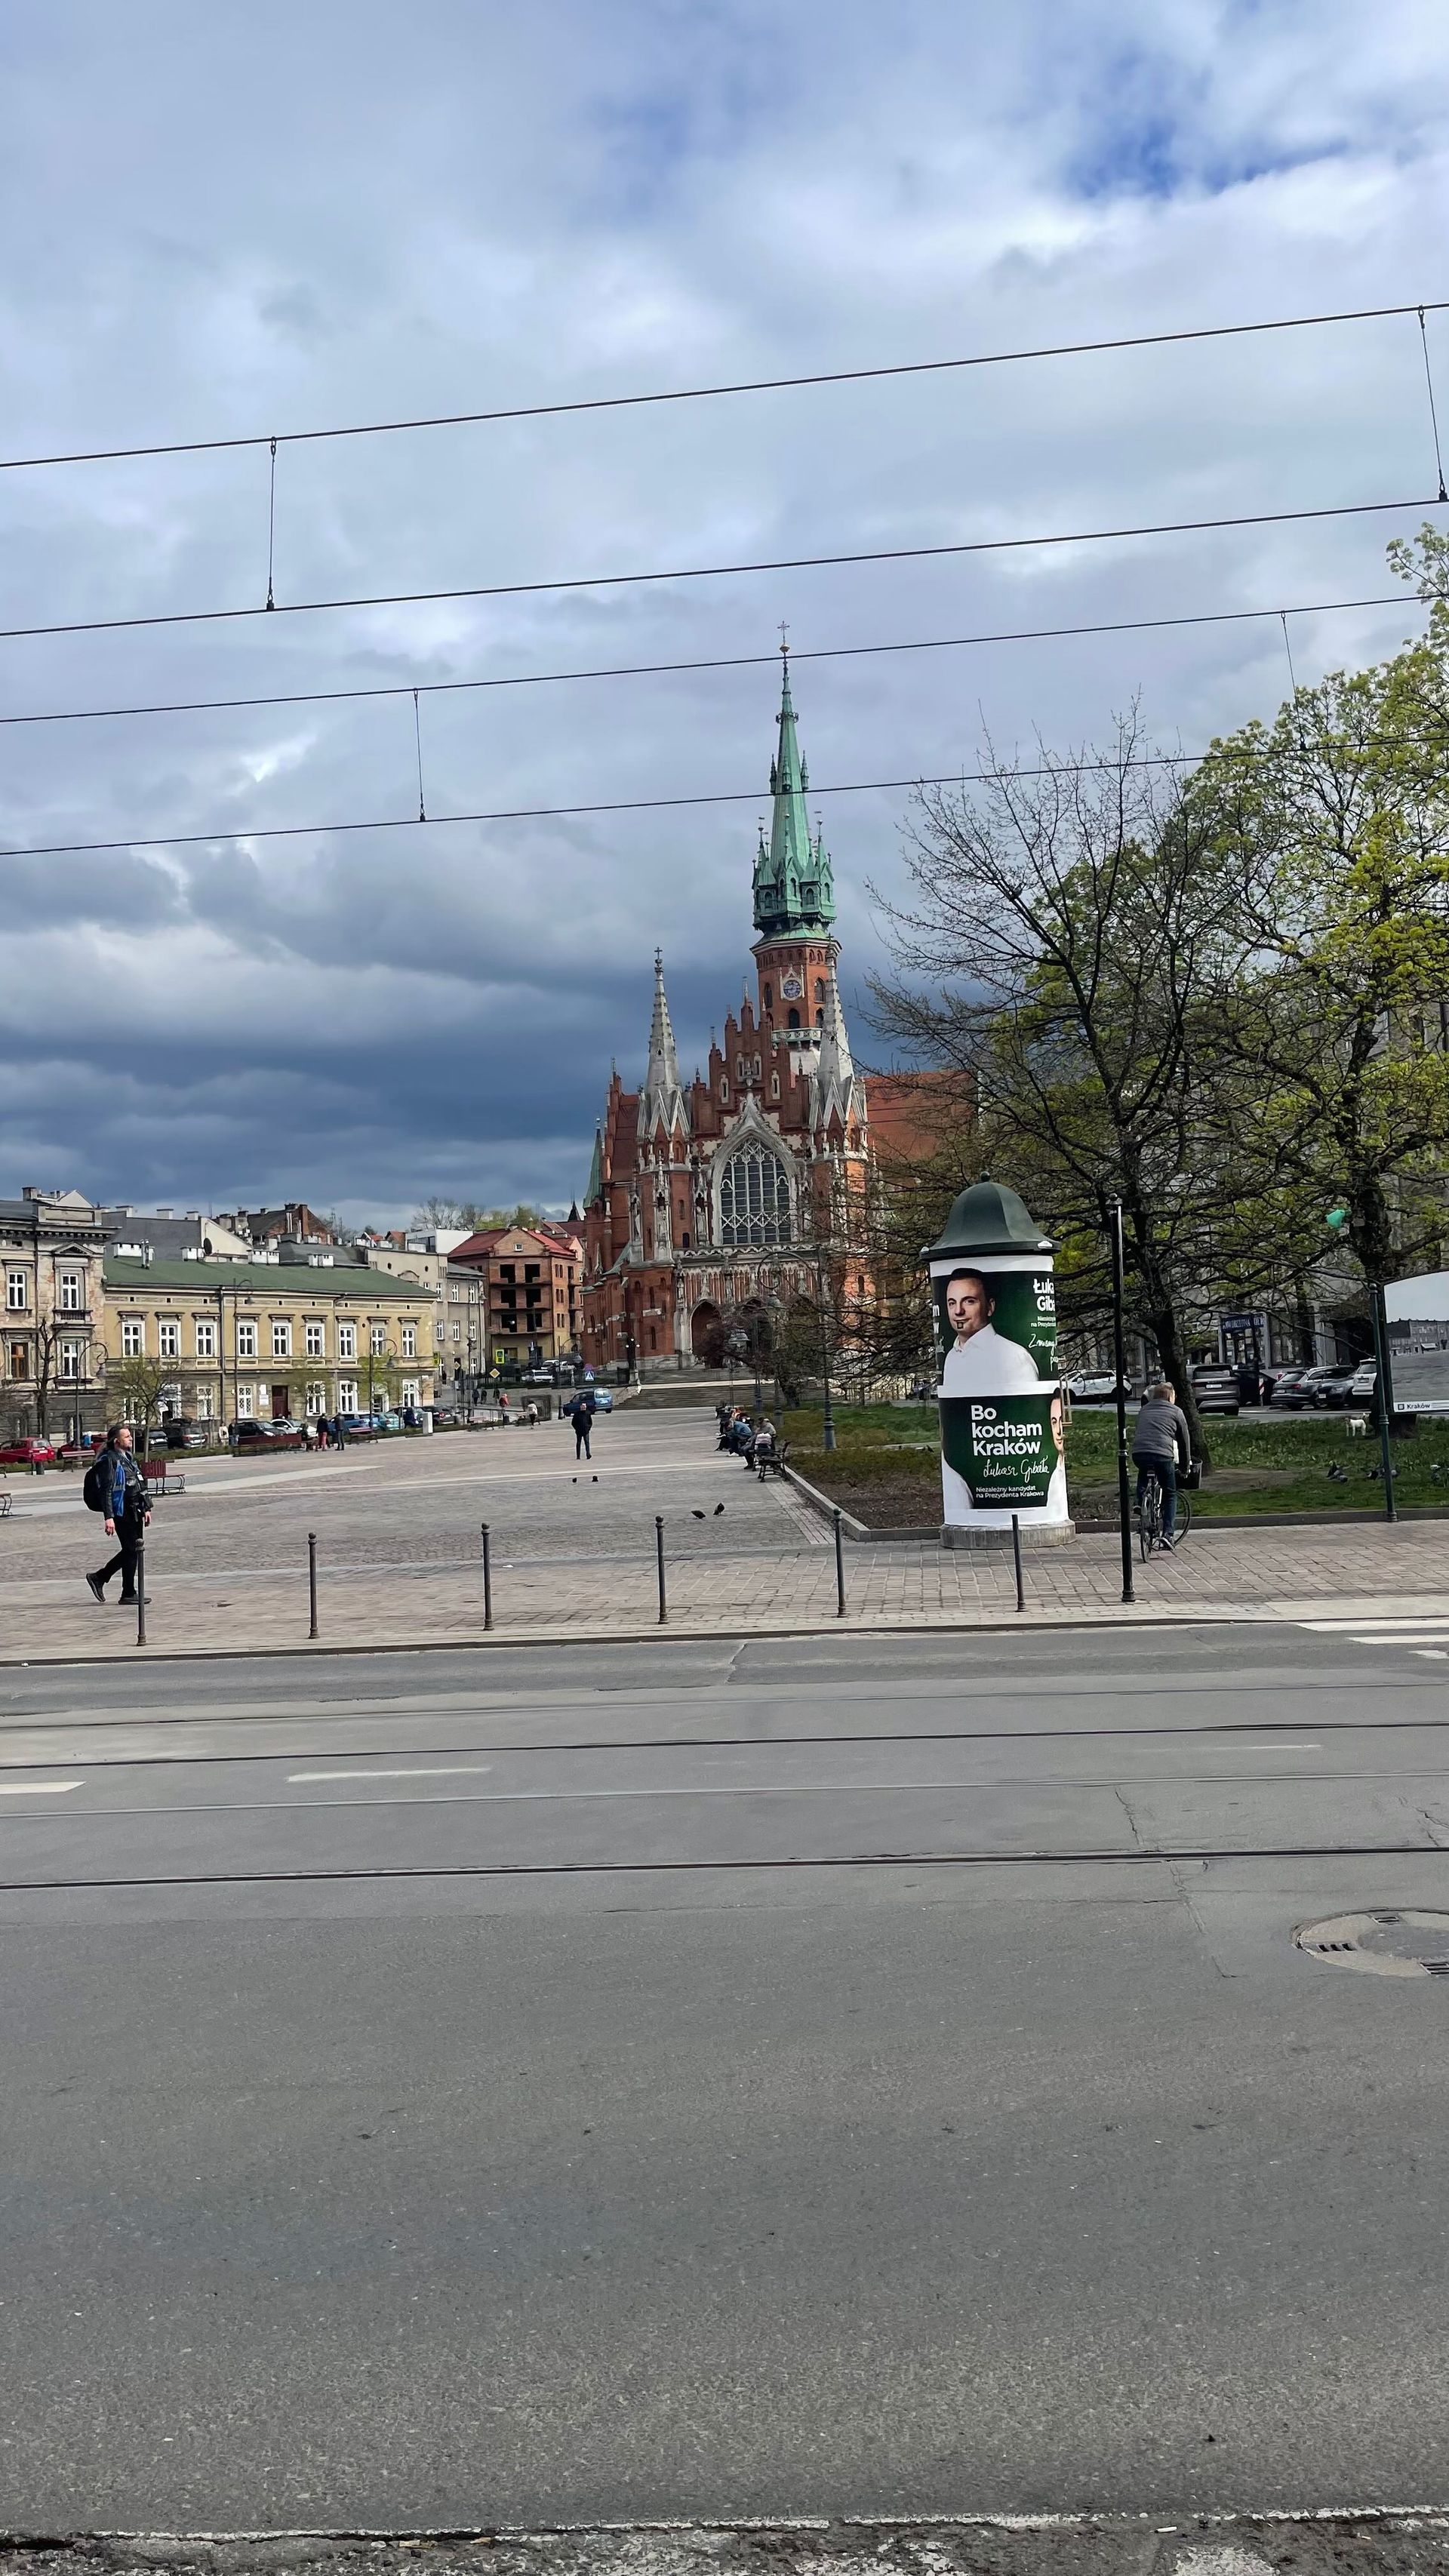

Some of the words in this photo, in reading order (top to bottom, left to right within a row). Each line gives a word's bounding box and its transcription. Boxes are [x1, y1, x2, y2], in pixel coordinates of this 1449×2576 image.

[971, 1405, 997, 1420] Bo
[971, 1420, 1042, 1439] kocham
[973, 1437, 1041, 1457] Kraków
[983, 1458, 1019, 1478] Łukasz
[984, 1491, 1020, 1500] Prezydenta
[1008, 1485, 1036, 1494] kandydat
